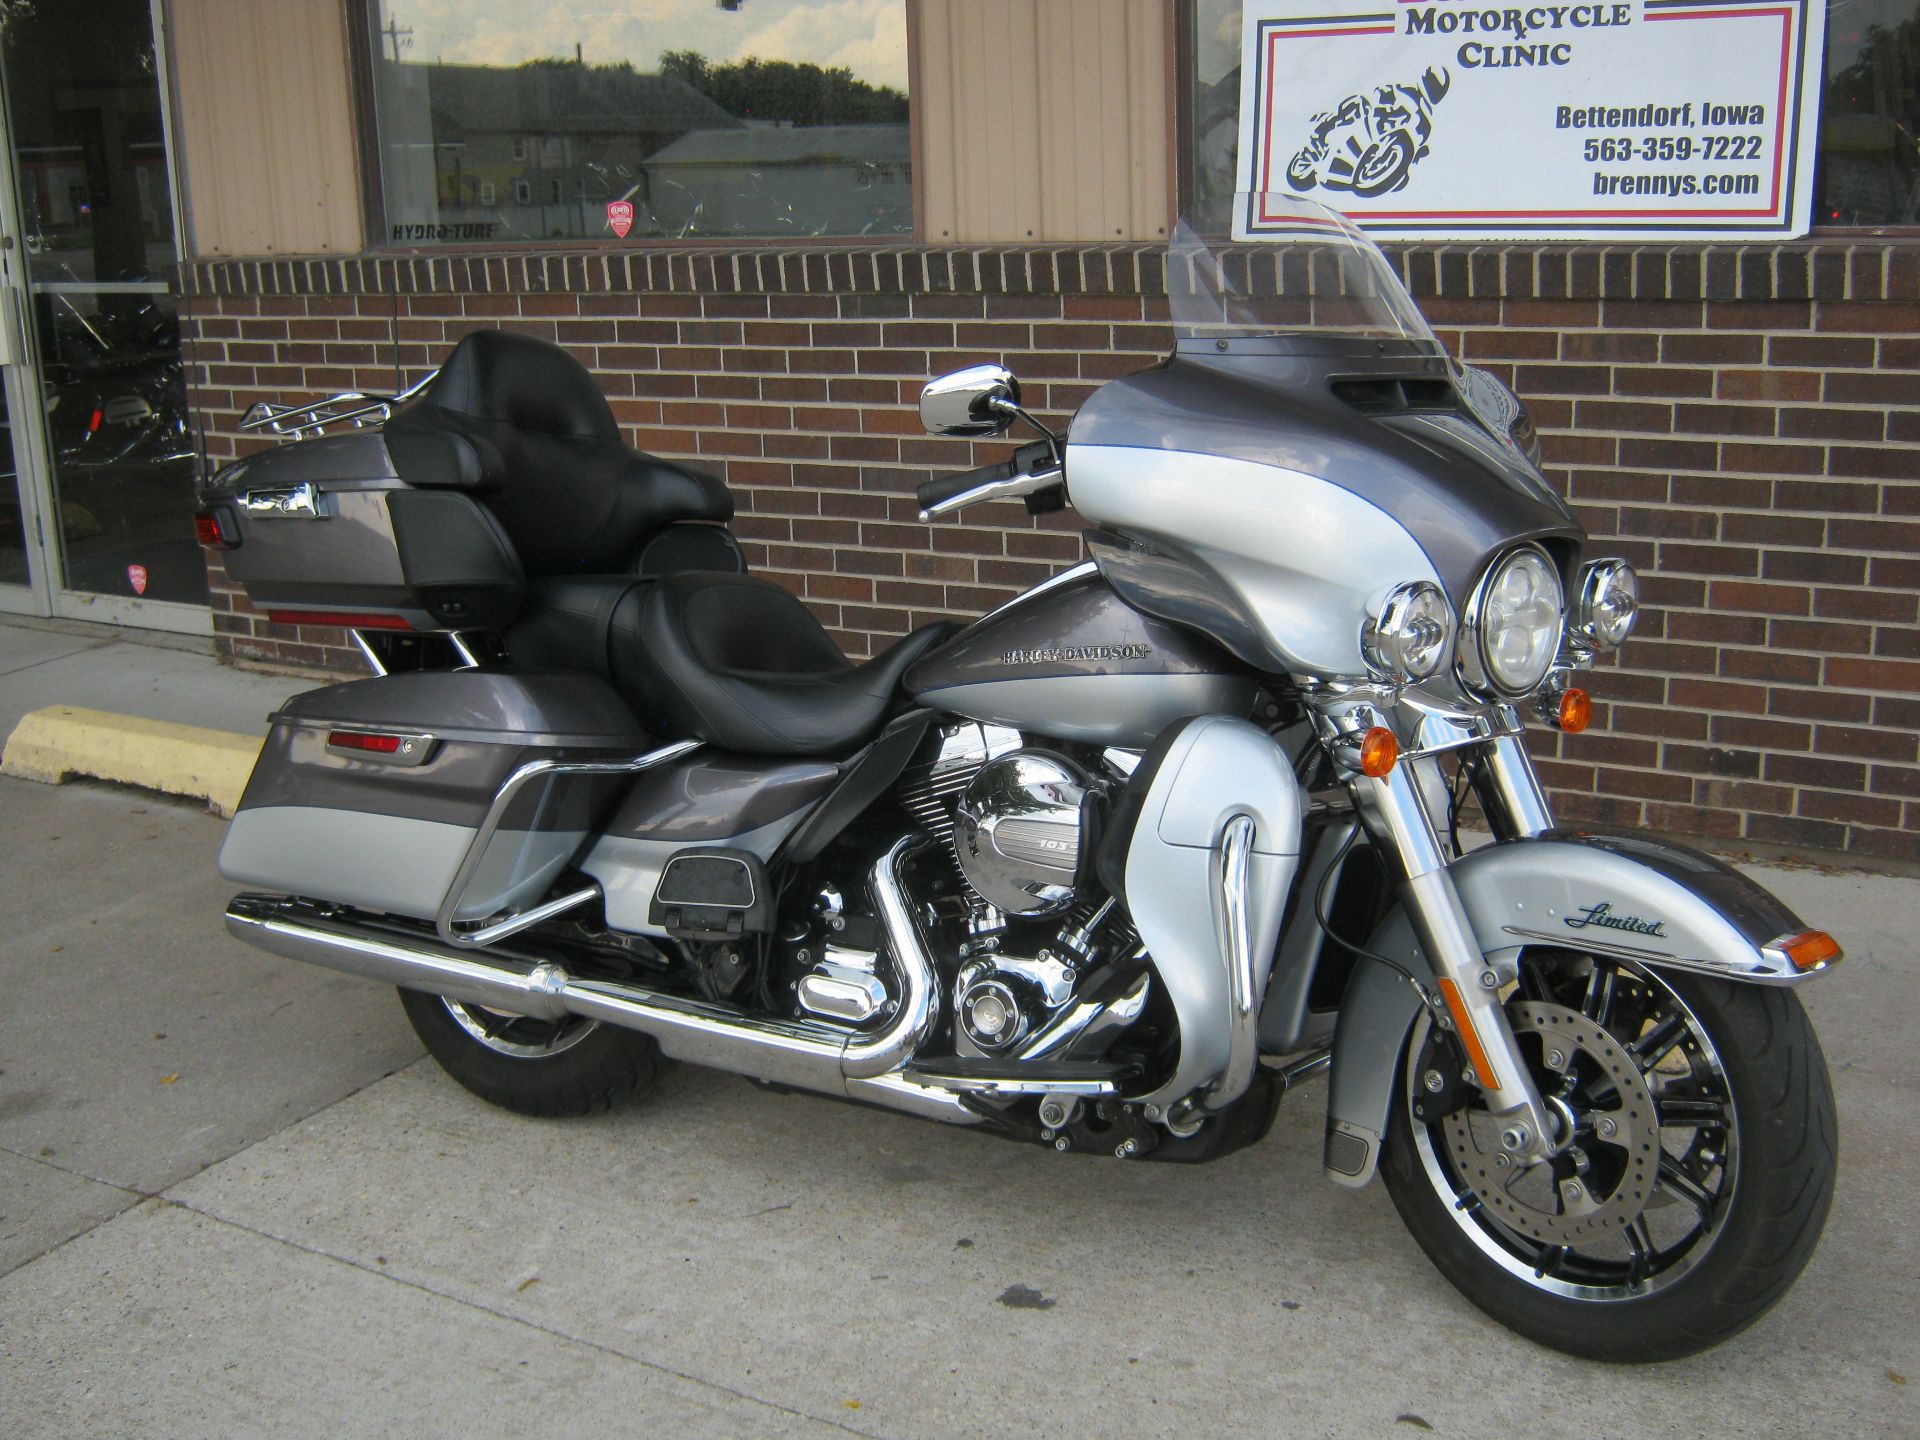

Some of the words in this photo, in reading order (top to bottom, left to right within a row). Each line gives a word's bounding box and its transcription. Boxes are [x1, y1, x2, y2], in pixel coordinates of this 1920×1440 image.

[1405, 4, 1631, 41] MOTORCYCLE
[1456, 42, 1572, 69] CLINIC
[1555, 102, 1696, 129] Bettendorf,
[1701, 102, 1765, 126] Iowa
[1583, 135, 1763, 162] 563-359-7222
[1593, 172, 1760, 197] brennys.com
[1040, 839, 1069, 851] 103
[1564, 902, 1668, 938] Limited
